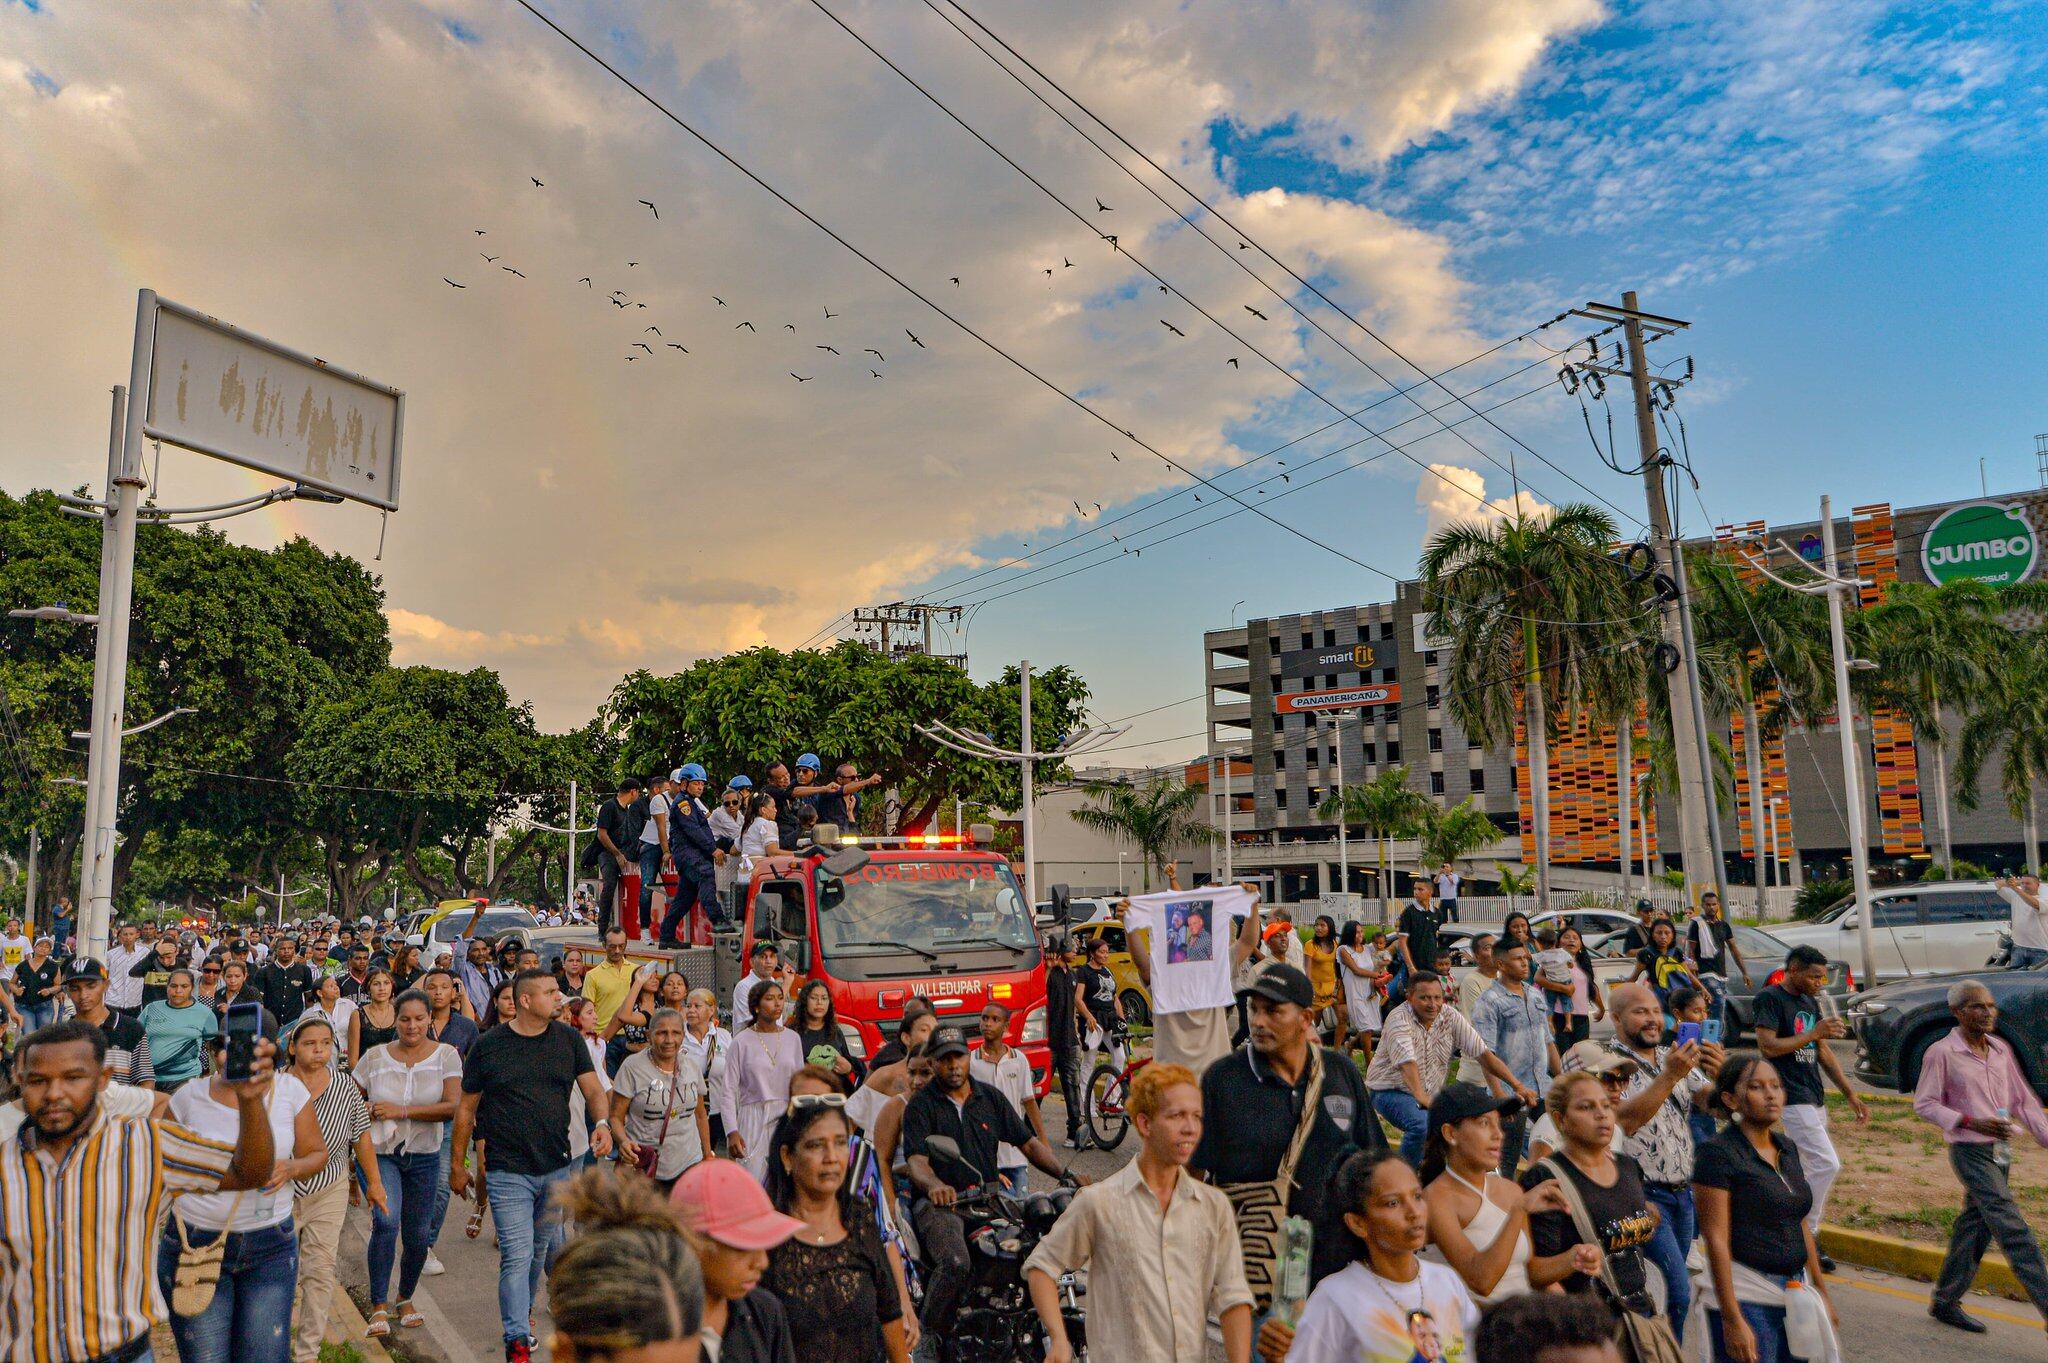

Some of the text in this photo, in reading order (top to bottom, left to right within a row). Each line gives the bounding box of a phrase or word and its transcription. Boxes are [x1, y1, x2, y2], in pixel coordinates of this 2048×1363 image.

[1930, 536, 2030, 565] JUMBO
[1319, 645, 1374, 665] smart fit
[1296, 691, 1381, 706] PANAMERICANA
[911, 980, 982, 997] VALLEDUPAR
